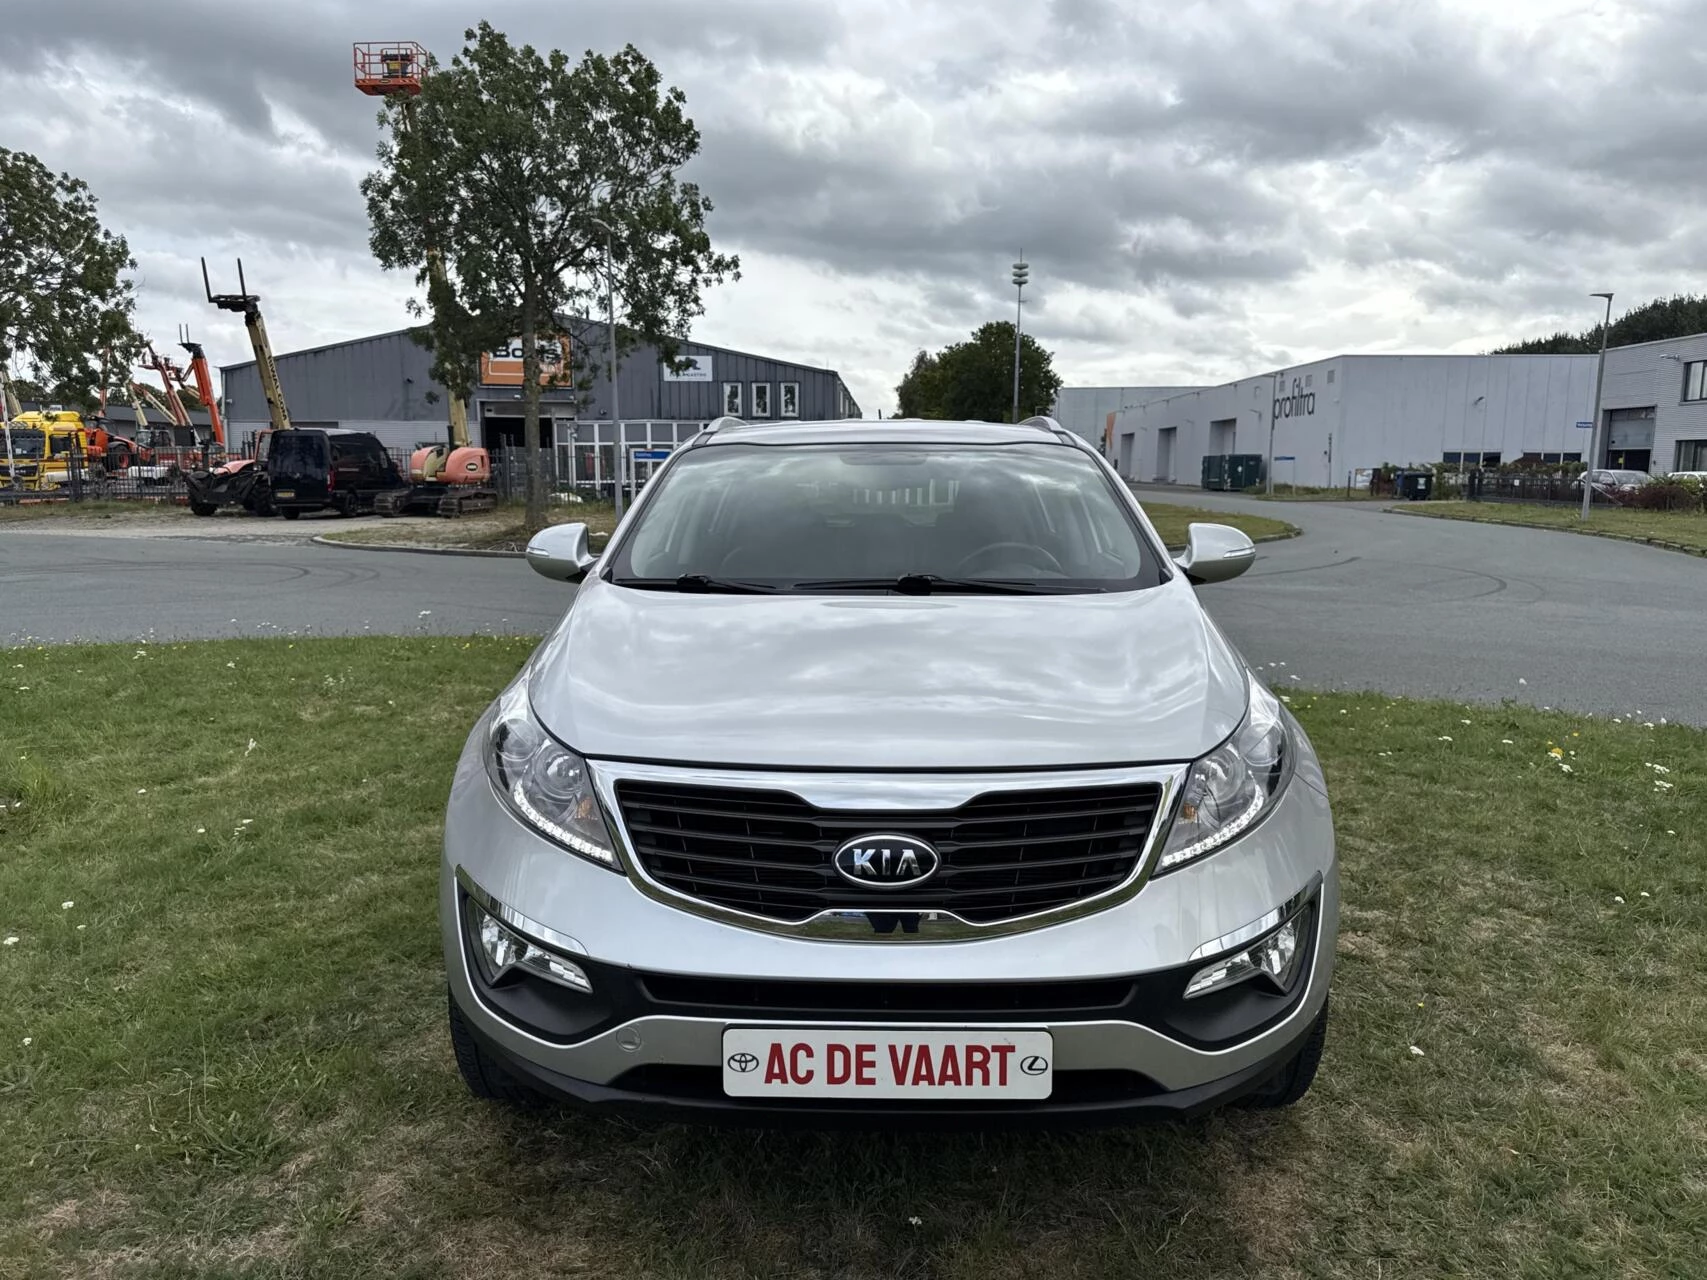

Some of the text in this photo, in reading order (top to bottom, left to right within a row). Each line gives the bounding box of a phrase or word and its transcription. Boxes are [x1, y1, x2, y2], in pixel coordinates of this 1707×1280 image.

[1272, 376, 1315, 427] profiltra
[852, 848, 922, 876] KIA
[764, 1043, 1016, 1087] AC DE VAART
